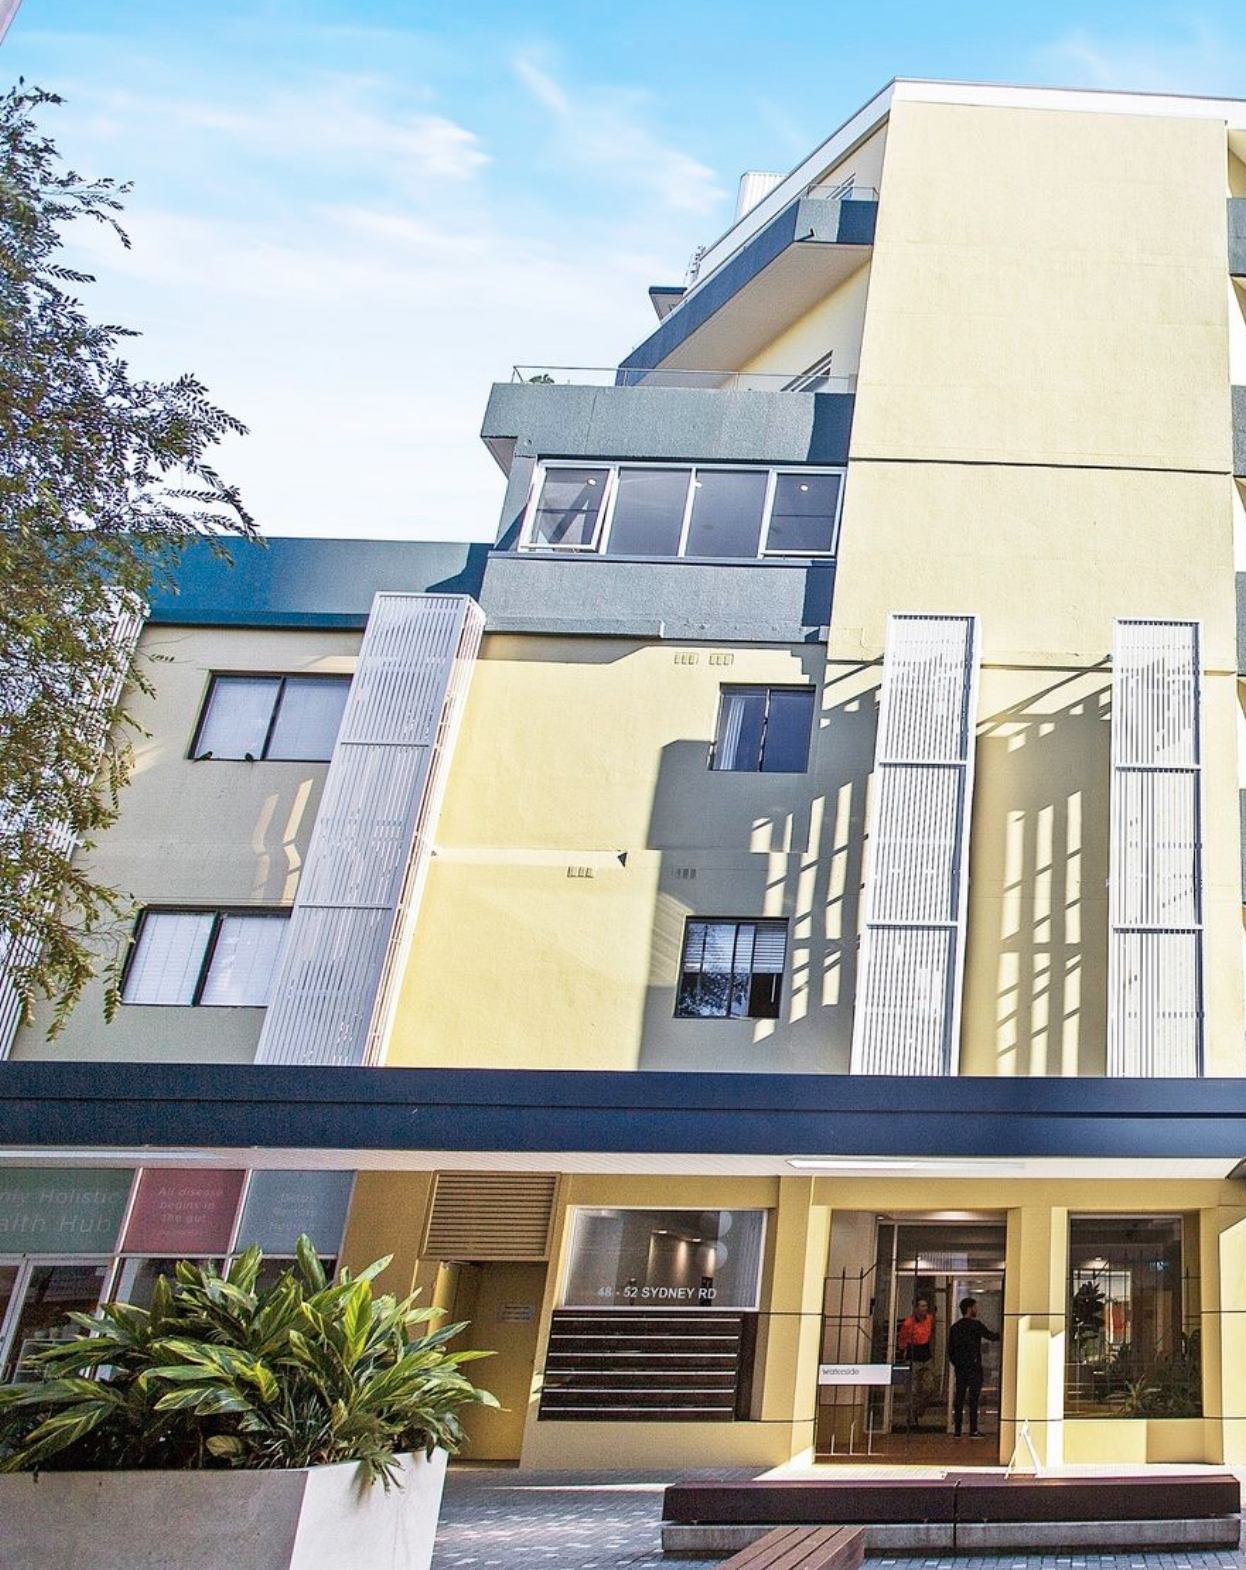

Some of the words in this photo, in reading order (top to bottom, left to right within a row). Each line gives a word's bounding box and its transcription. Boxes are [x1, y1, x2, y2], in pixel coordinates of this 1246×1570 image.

[38, 1188, 123, 1204] Holistic
[59, 1214, 112, 1233] Hub
[597, 1286, 612, 1297] 48
[623, 1286, 638, 1298] 52
[641, 1286, 696, 1299] SYDNEY
[698, 1287, 717, 1299] RD
